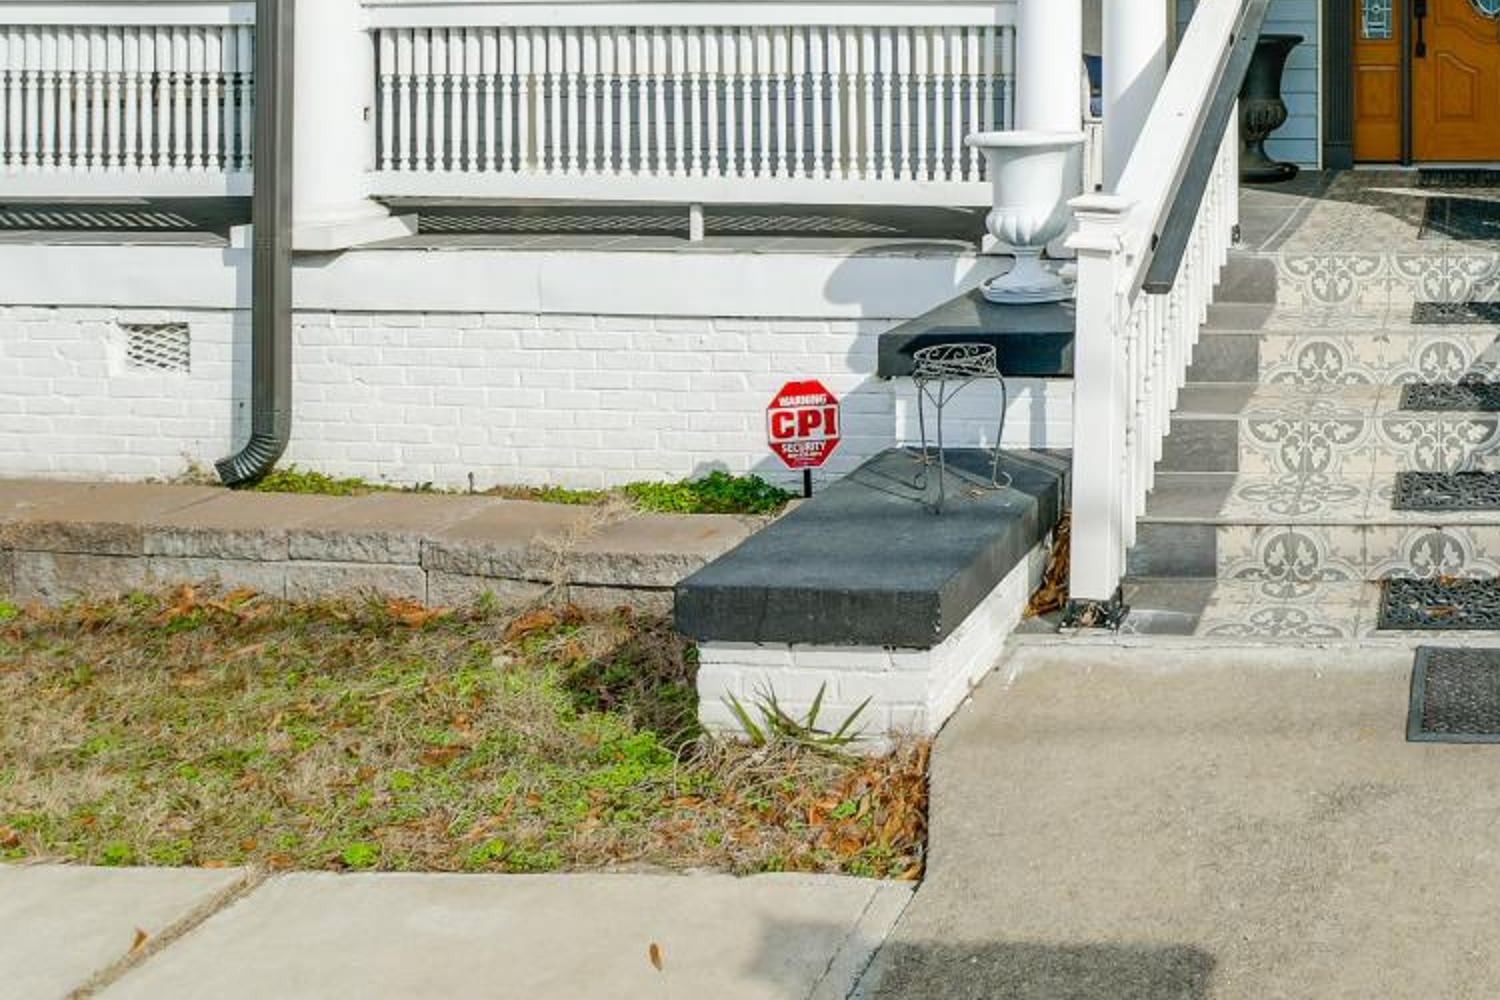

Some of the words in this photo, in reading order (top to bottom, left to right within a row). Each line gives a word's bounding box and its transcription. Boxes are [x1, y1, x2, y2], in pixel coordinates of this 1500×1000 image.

[778, 394, 827, 406] WARNING
[771, 409, 837, 439] CPI
[781, 441, 825, 453] SECURITY
